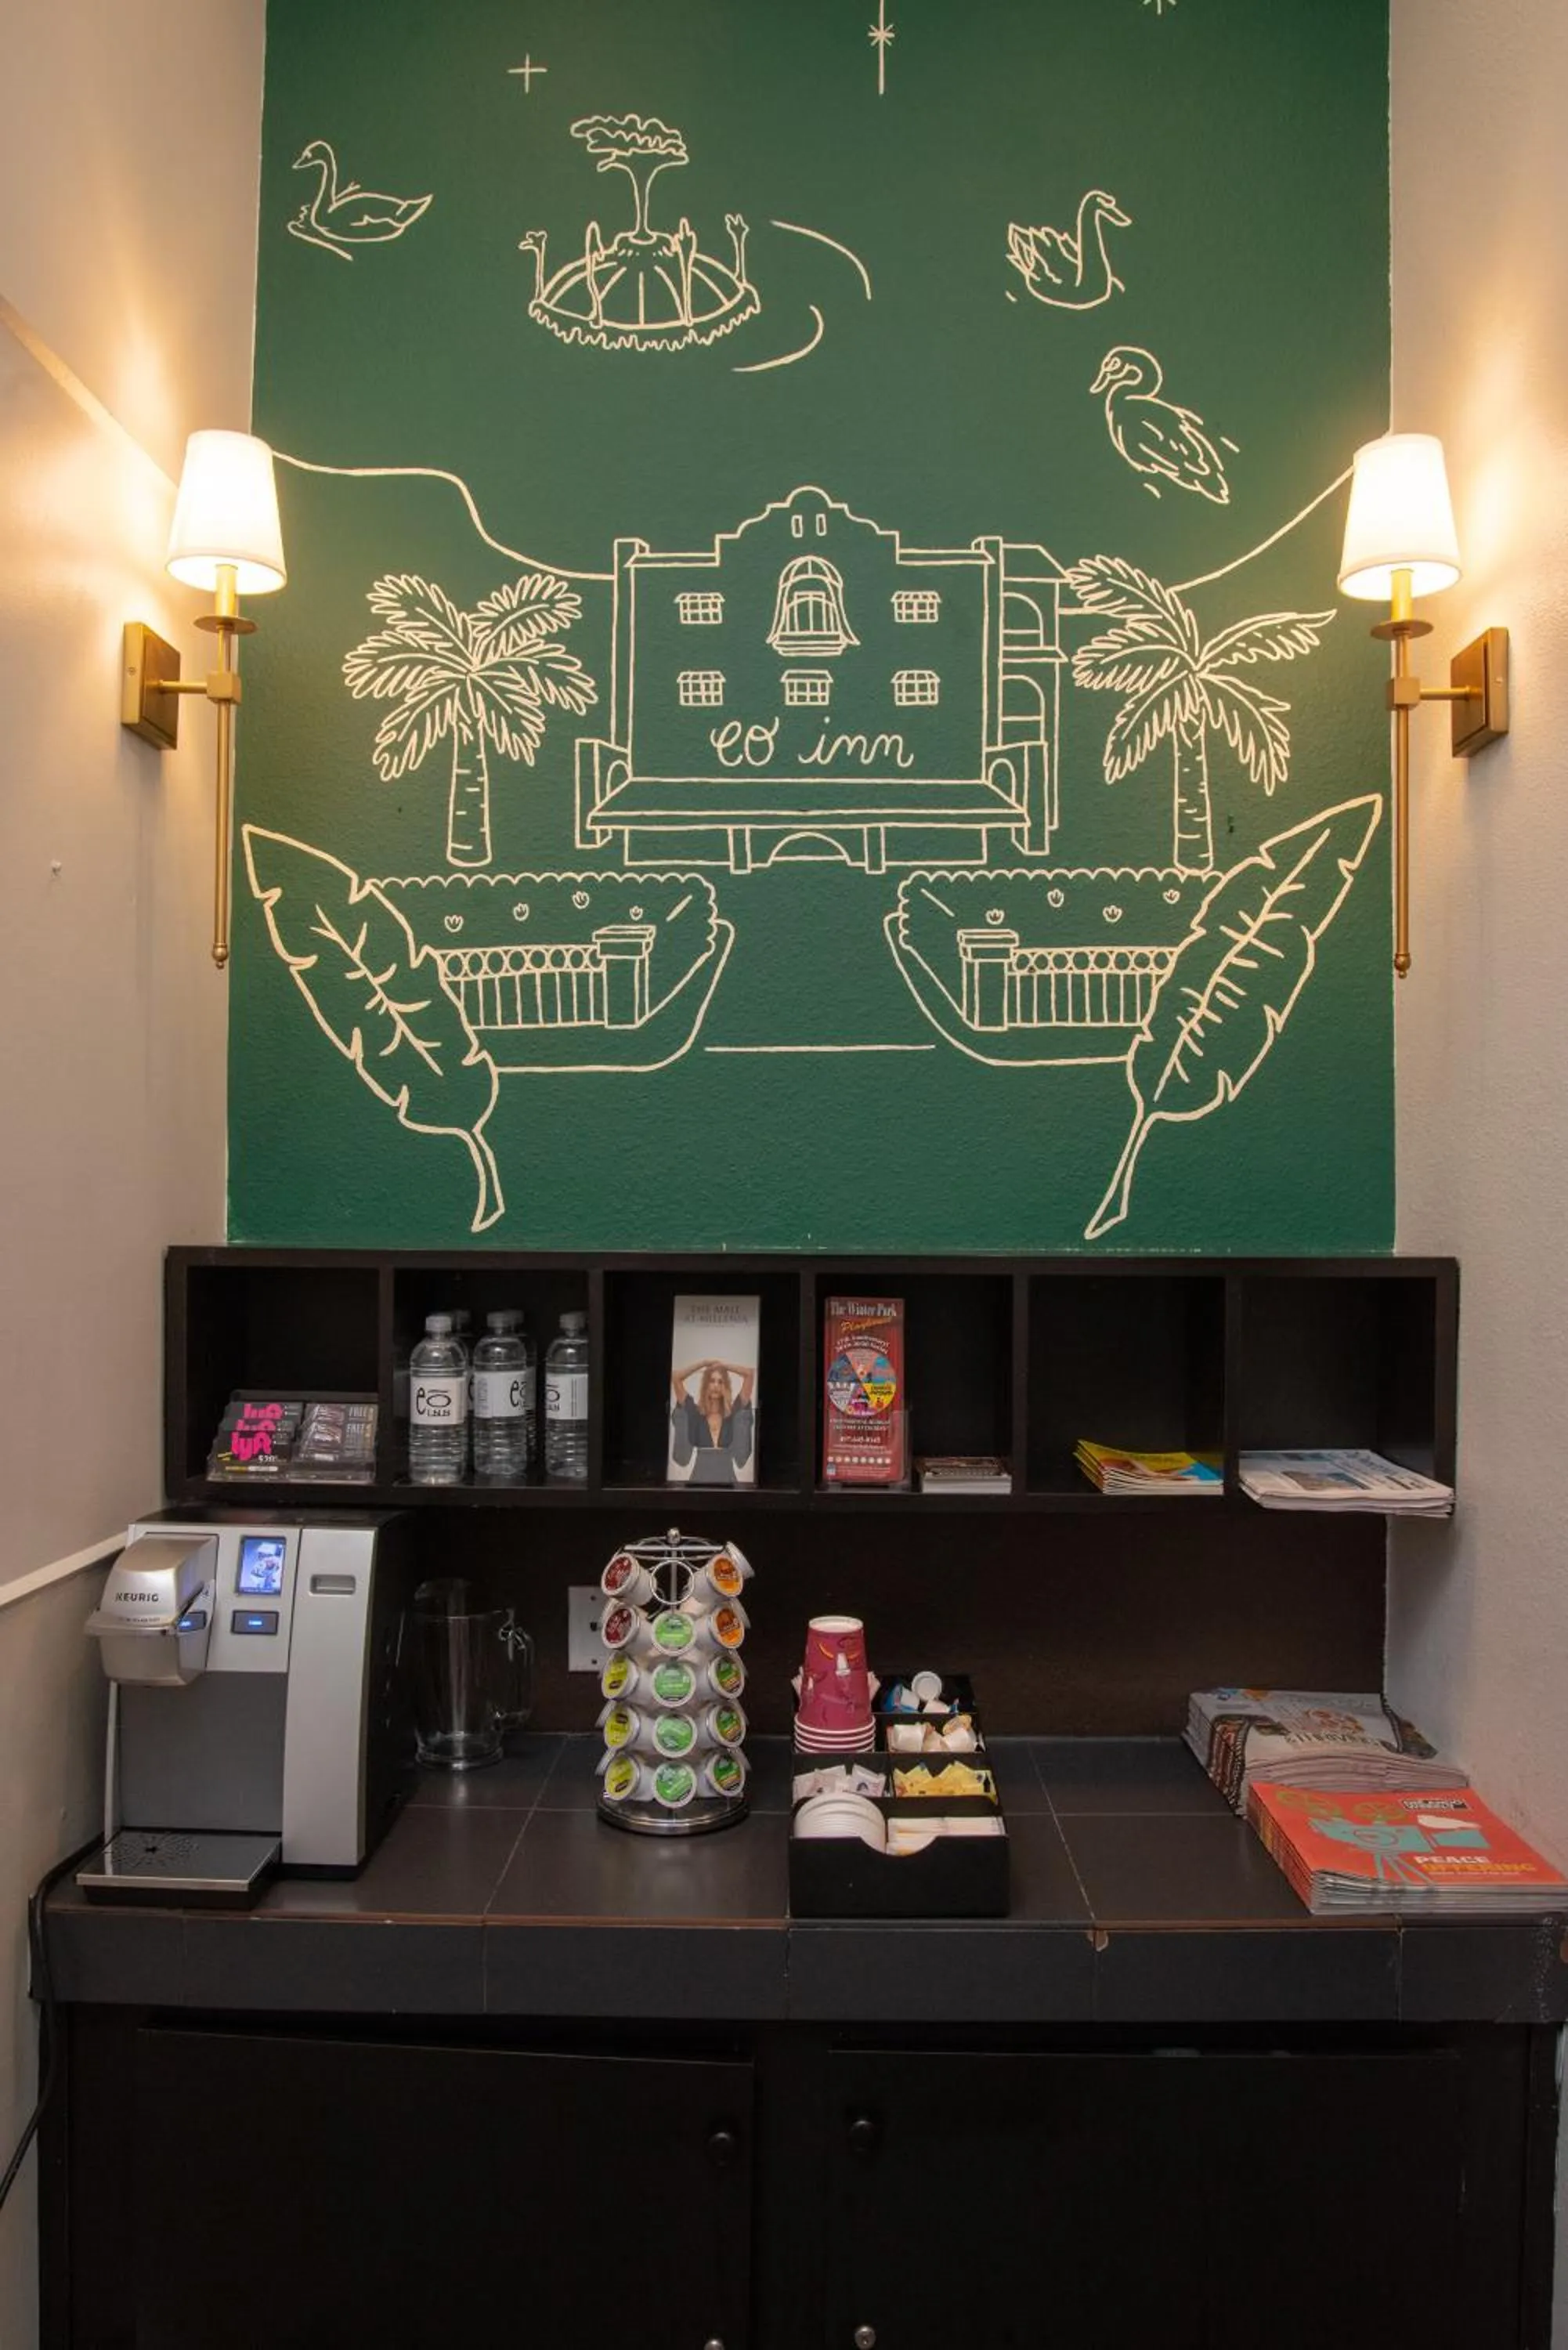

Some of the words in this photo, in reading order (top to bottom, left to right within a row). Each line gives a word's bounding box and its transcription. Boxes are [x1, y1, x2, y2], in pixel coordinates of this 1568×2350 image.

[797, 716, 914, 768] inn
[230, 1431, 272, 1460] lyft
[115, 1592, 159, 1603] KEURIG
[1413, 1855, 1490, 1864] PEACE
